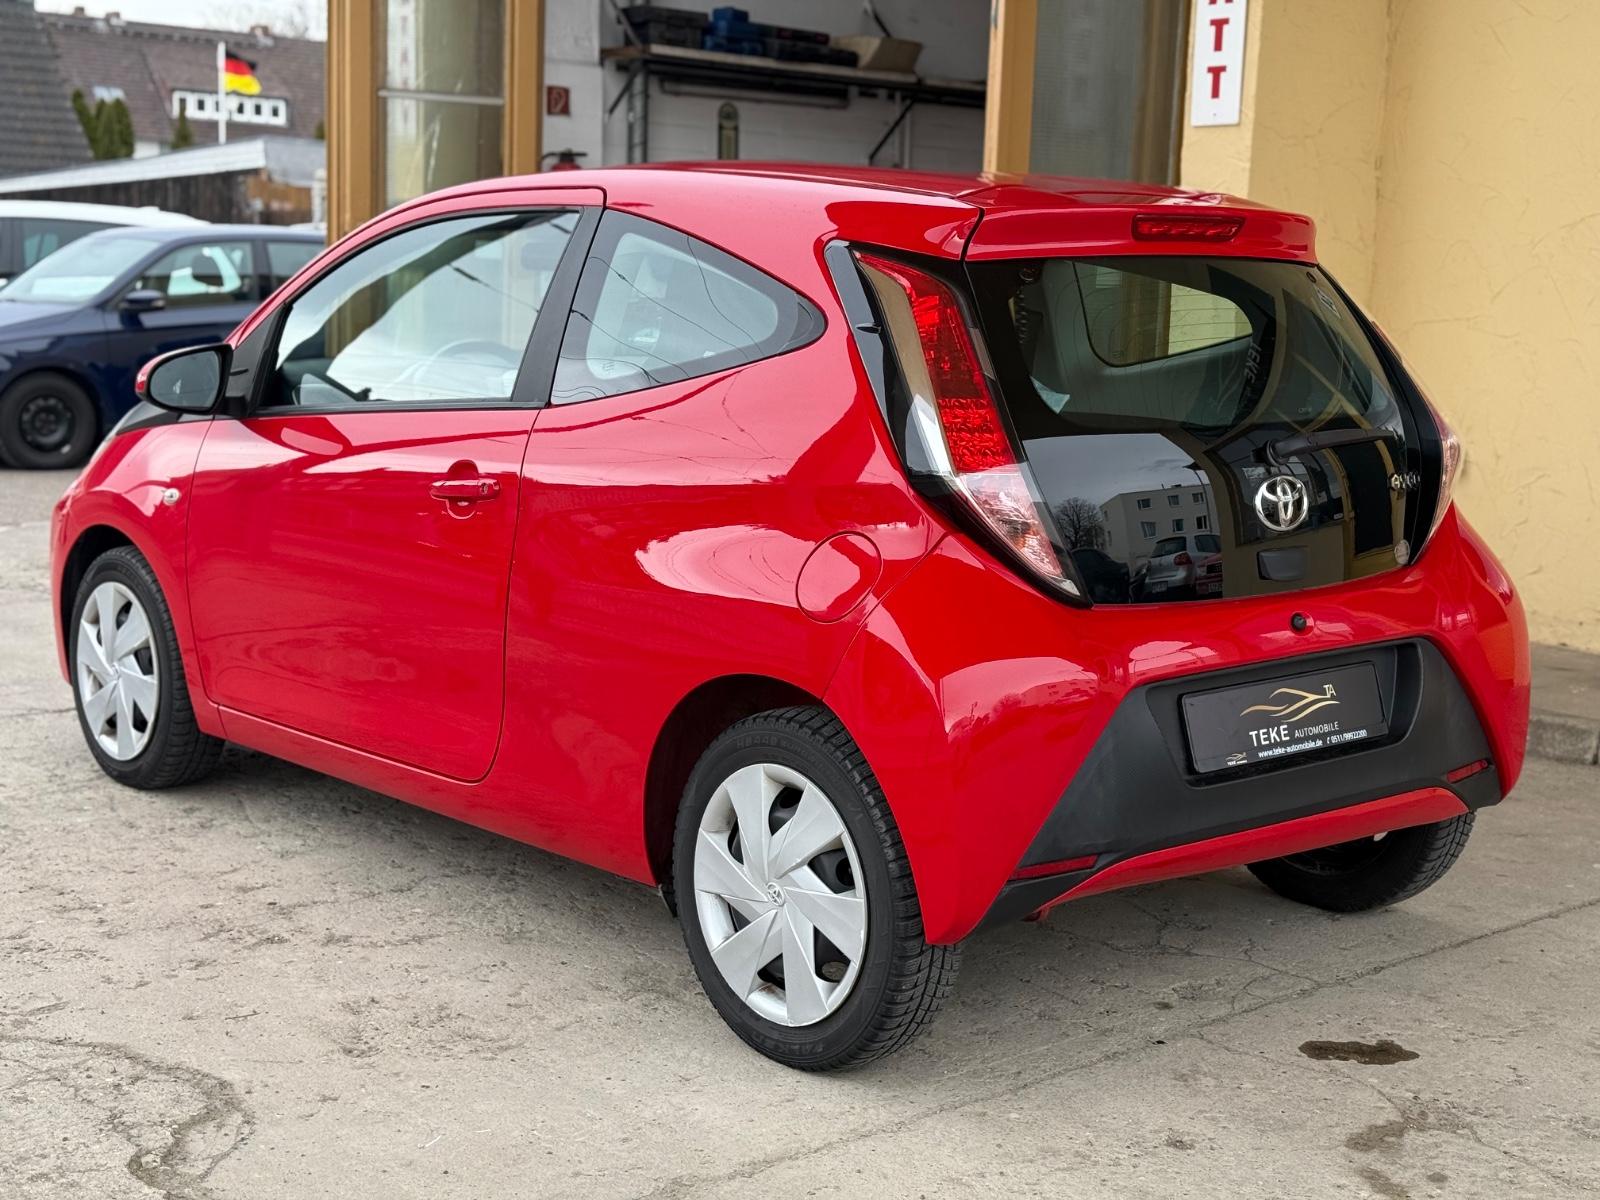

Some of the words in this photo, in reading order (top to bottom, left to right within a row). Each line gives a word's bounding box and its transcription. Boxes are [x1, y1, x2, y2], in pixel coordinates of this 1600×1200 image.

[1206, 0, 1233, 99] TT
[1250, 726, 1290, 747] TEKE
[1295, 722, 1339, 738] AUTOMOBILE
[1258, 740, 1322, 758] www.teke-automobile.de
